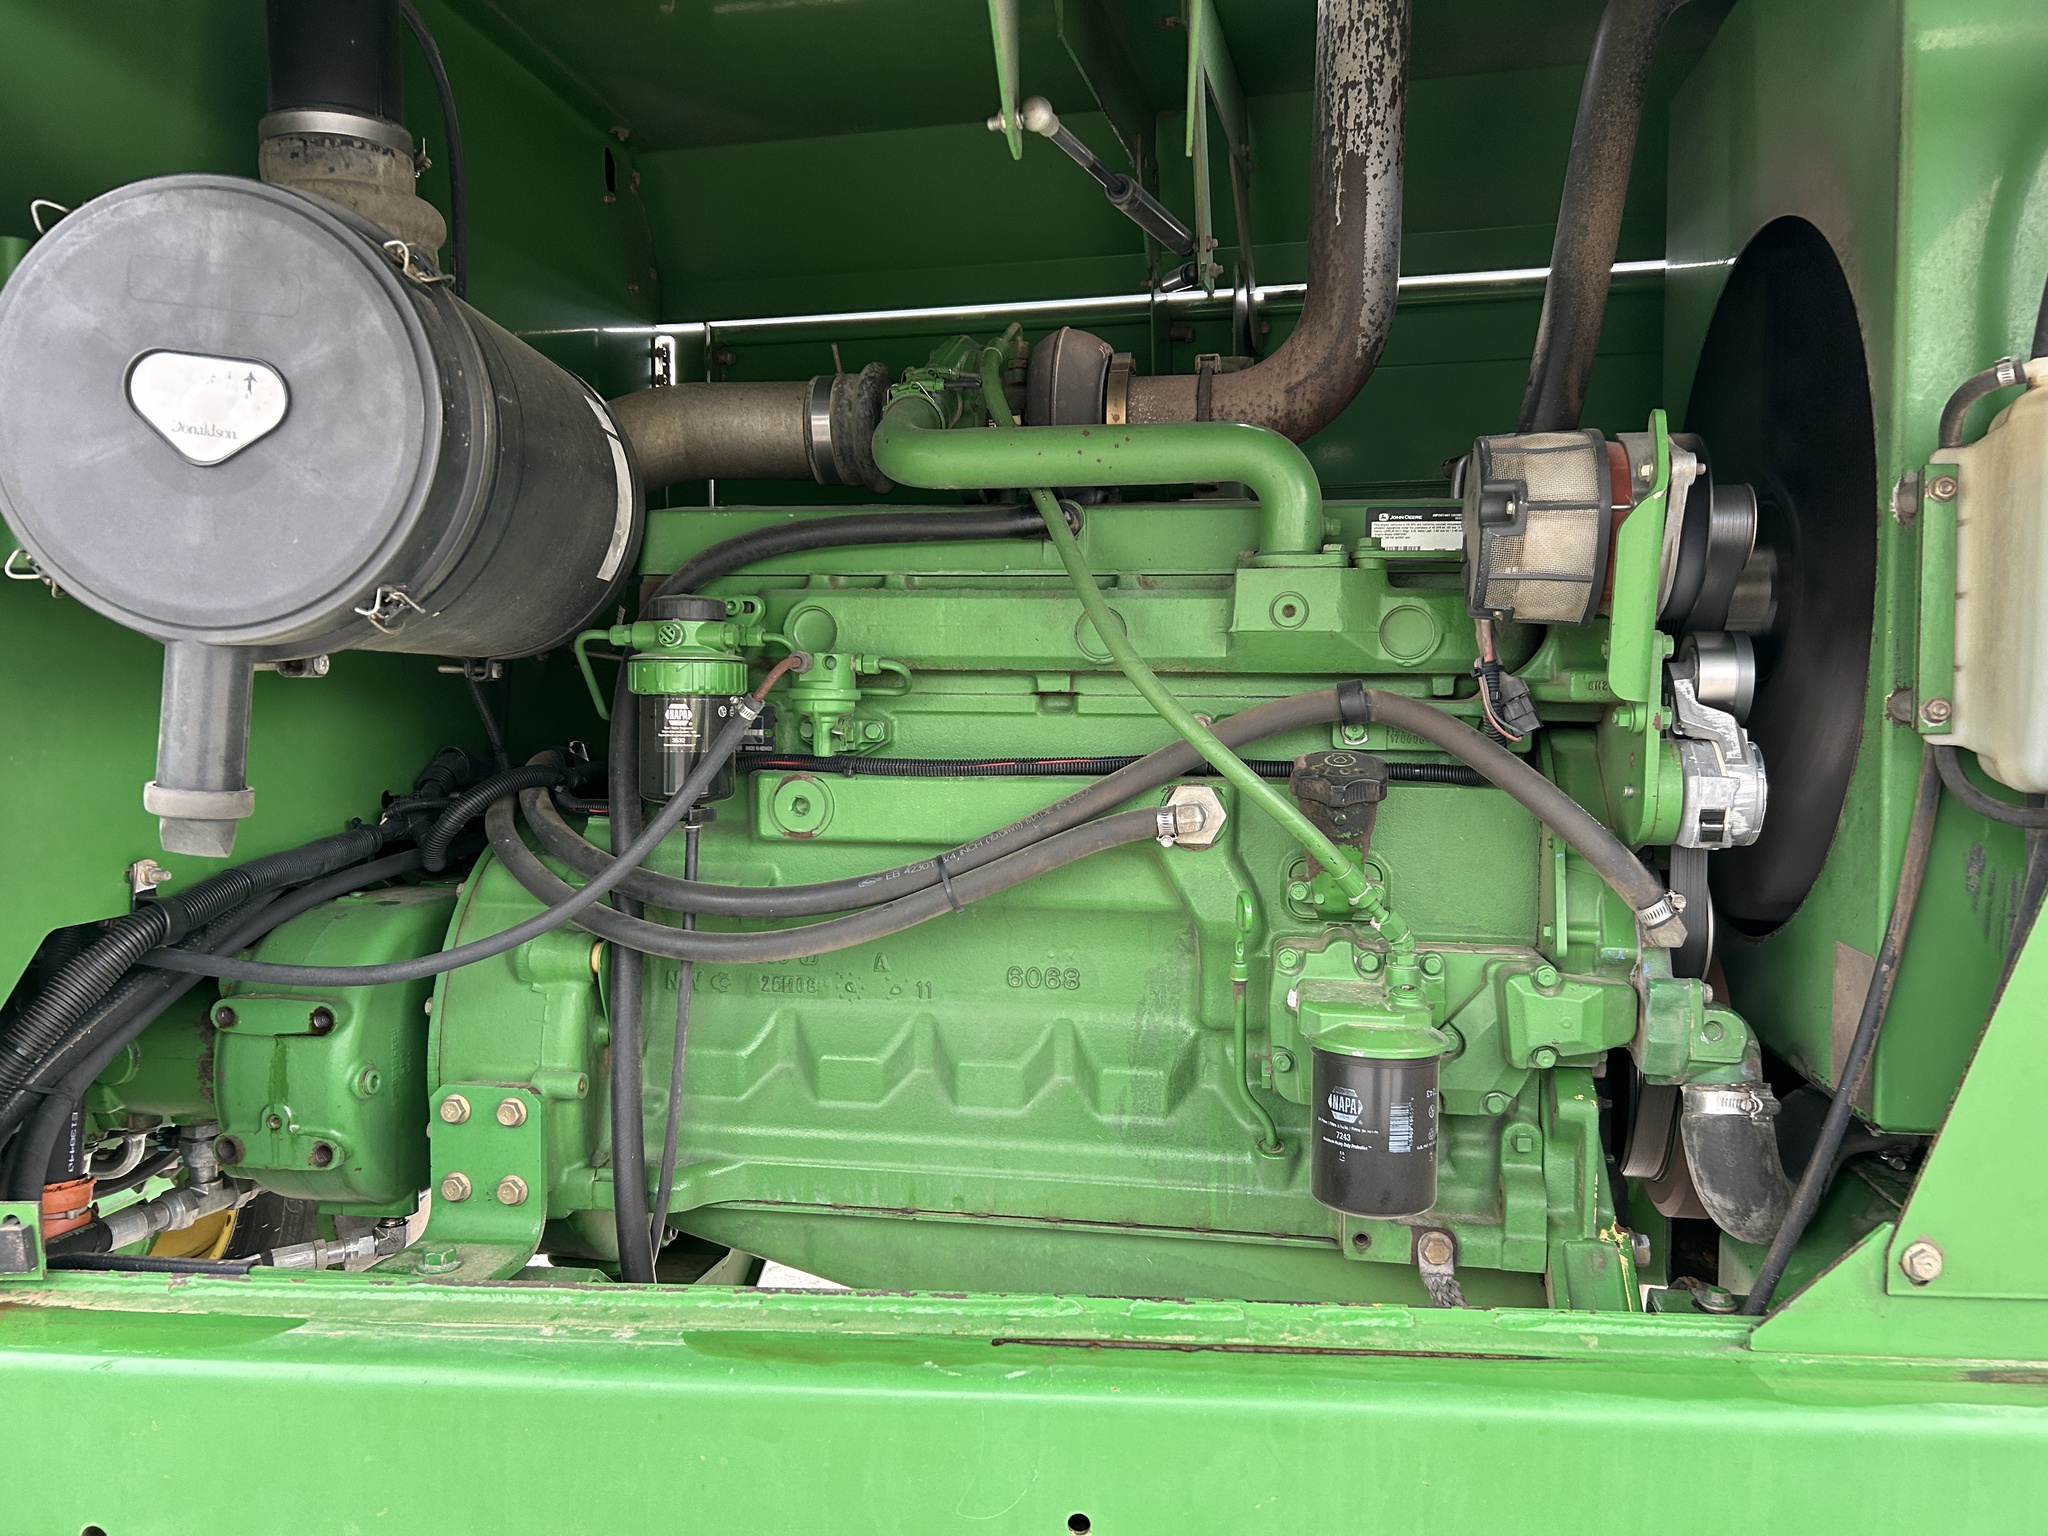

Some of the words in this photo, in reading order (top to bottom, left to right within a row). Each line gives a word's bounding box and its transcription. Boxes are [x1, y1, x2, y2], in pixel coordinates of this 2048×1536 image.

[669, 709, 689, 720] NAPA
[1007, 965, 1080, 990] 6068
[1332, 1095, 1357, 1114] NAPA
[1335, 1131, 1351, 1142] 7243
